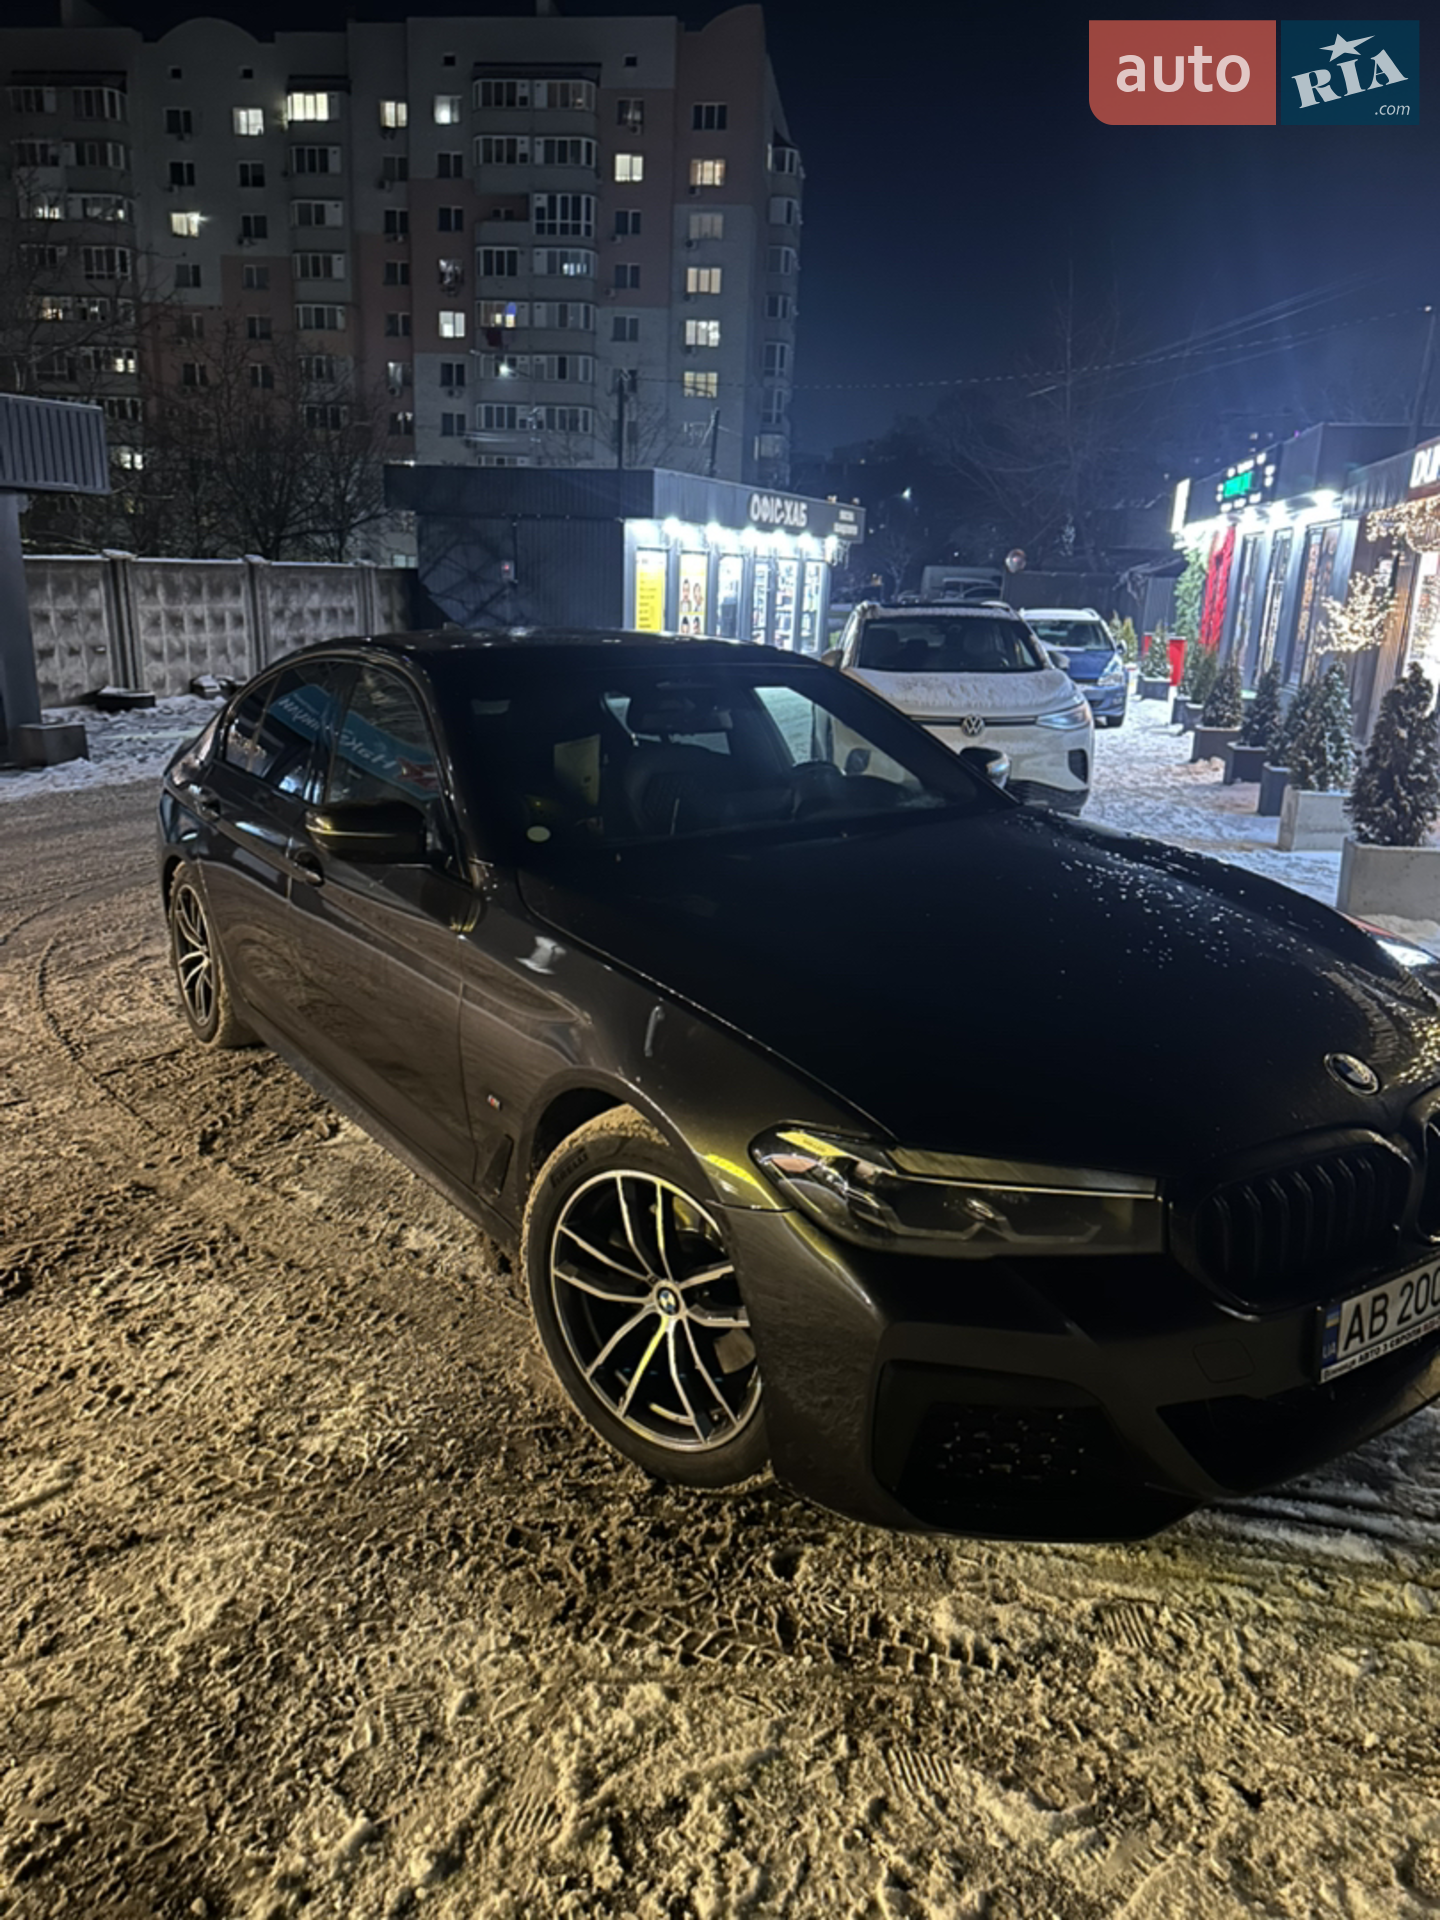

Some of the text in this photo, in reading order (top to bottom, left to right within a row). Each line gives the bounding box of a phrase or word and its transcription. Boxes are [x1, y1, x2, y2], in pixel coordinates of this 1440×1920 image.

[1409, 444, 1440, 488] DU
[749, 492, 808, 528] ОФІС-ХАБ
[1342, 1292, 1390, 1352] AB
[1322, 1342, 1337, 1359] UA
